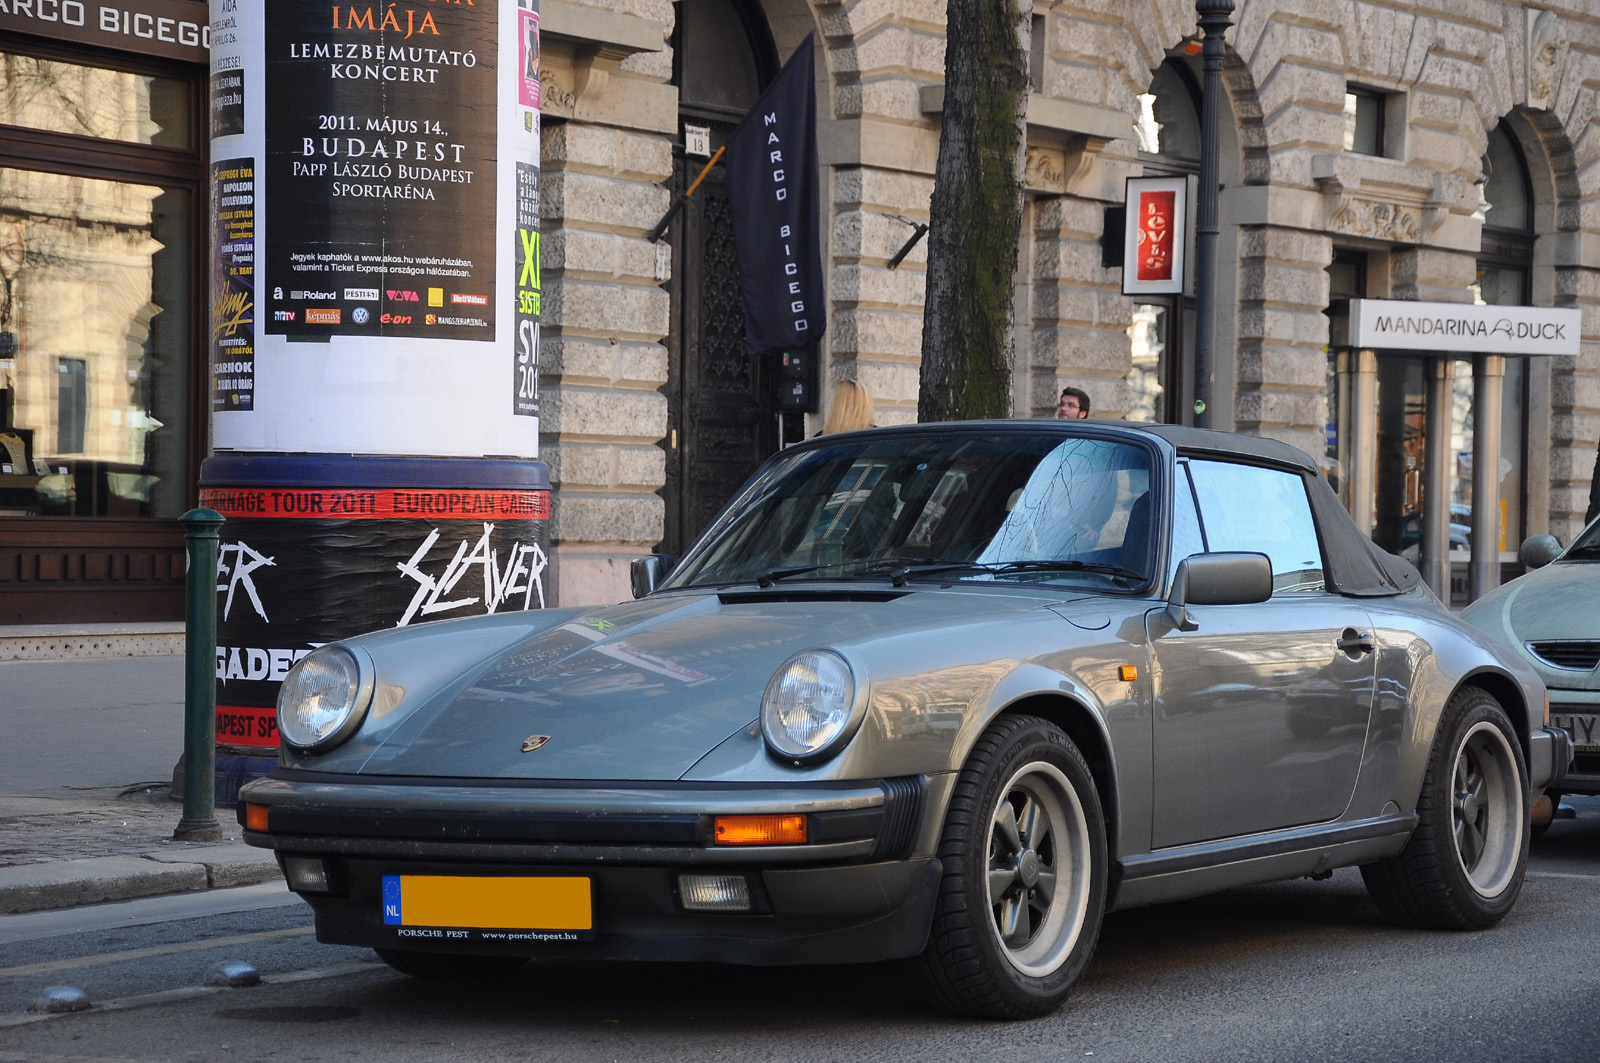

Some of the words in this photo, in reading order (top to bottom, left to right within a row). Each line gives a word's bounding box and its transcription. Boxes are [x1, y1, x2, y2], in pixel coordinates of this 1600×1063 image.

[331, 2, 441, 40] IMÁJA
[290, 43, 477, 68] LEMEZBEMUTATÓ
[330, 63, 439, 84] KONCERT
[318, 114, 361, 131] 2011.
[365, 116, 418, 136] MÁJUS
[423, 119, 449, 137] 14.,
[302, 137, 465, 163] BUDAPEST
[693, 138, 704, 152] 13
[240, 166, 253, 178] ÉVA
[293, 161, 328, 177] PAPP
[333, 161, 392, 178] LÁSZLÓ
[398, 164, 474, 184] BUDAPEST
[223, 181, 253, 193] NAPOLEON
[332, 181, 436, 201] SPORTARÉNA
[221, 195, 253, 207] BOULEVARD
[764, 111, 788, 201] MARCO
[780, 224, 808, 332] BICEGO
[234, 241, 253, 252] ISTVÁN
[240, 266, 253, 276] BEAT
[290, 253, 316, 263] Jegyek
[317, 253, 352, 263] kaphatók
[361, 255, 414, 265] www.akos.hu
[415, 256, 474, 268] webáruházában,
[292, 263, 323, 272] valamint
[331, 263, 355, 272] Ticket
[356, 263, 388, 274] Express
[389, 266, 425, 276] országos
[426, 267, 472, 278] hálózatában.
[303, 290, 337, 300] Roland
[306, 309, 340, 323] képmás
[1375, 316, 1488, 337] MANDARINA
[1517, 322, 1566, 340] DUCK
[271, 492, 323, 513] TOUR
[330, 492, 375, 513] 2011
[393, 492, 495, 513] EUROPEAN
[216, 540, 277, 623] ER
[396, 521, 548, 629] SLAYER
[215, 643, 320, 688] GADE
[216, 714, 255, 737] APEST
[258, 716, 280, 738] SP
[1550, 716, 1597, 744] HY
[386, 904, 400, 917] NL
[397, 929, 443, 938] PORSCHE
[446, 929, 470, 938] PEST
[481, 931, 578, 941] www.porschepest.hu
